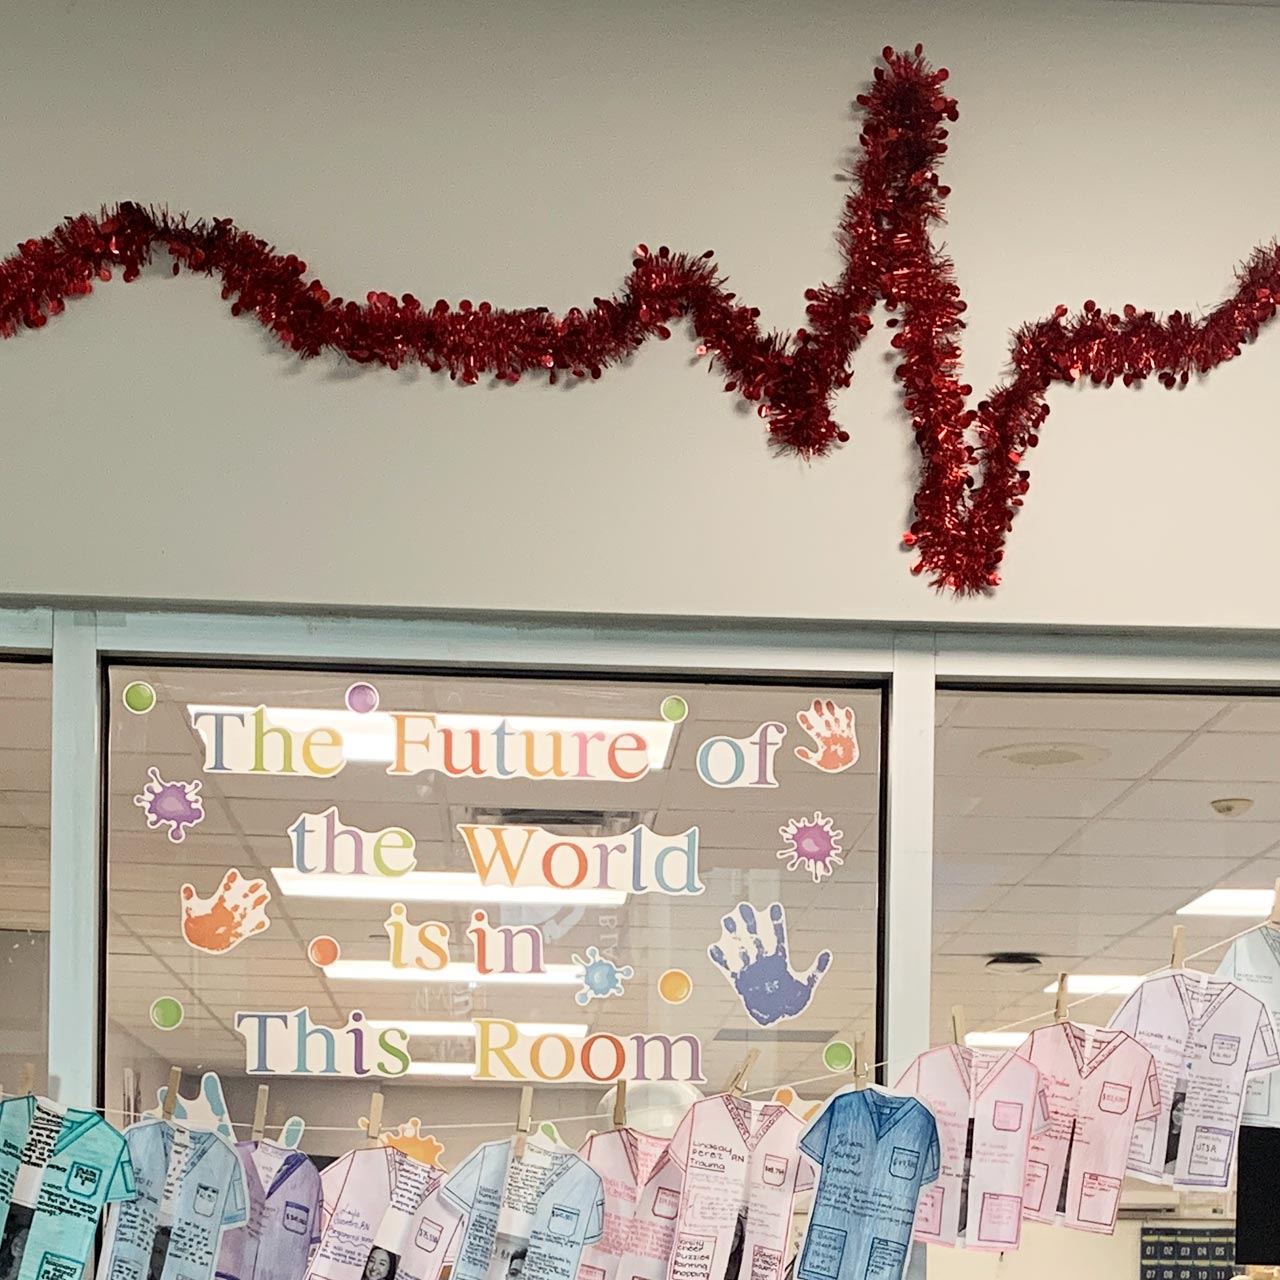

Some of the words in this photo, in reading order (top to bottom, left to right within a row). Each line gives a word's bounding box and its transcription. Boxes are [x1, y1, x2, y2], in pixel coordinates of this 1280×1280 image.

[194, 710, 344, 776] The
[389, 714, 651, 780] Future
[697, 721, 786, 788] of
[289, 811, 416, 877] the
[461, 826, 706, 894] World
[391, 905, 450, 970] is
[468, 911, 546, 975] in
[238, 1012, 410, 1075] This
[474, 1019, 706, 1081] Room
